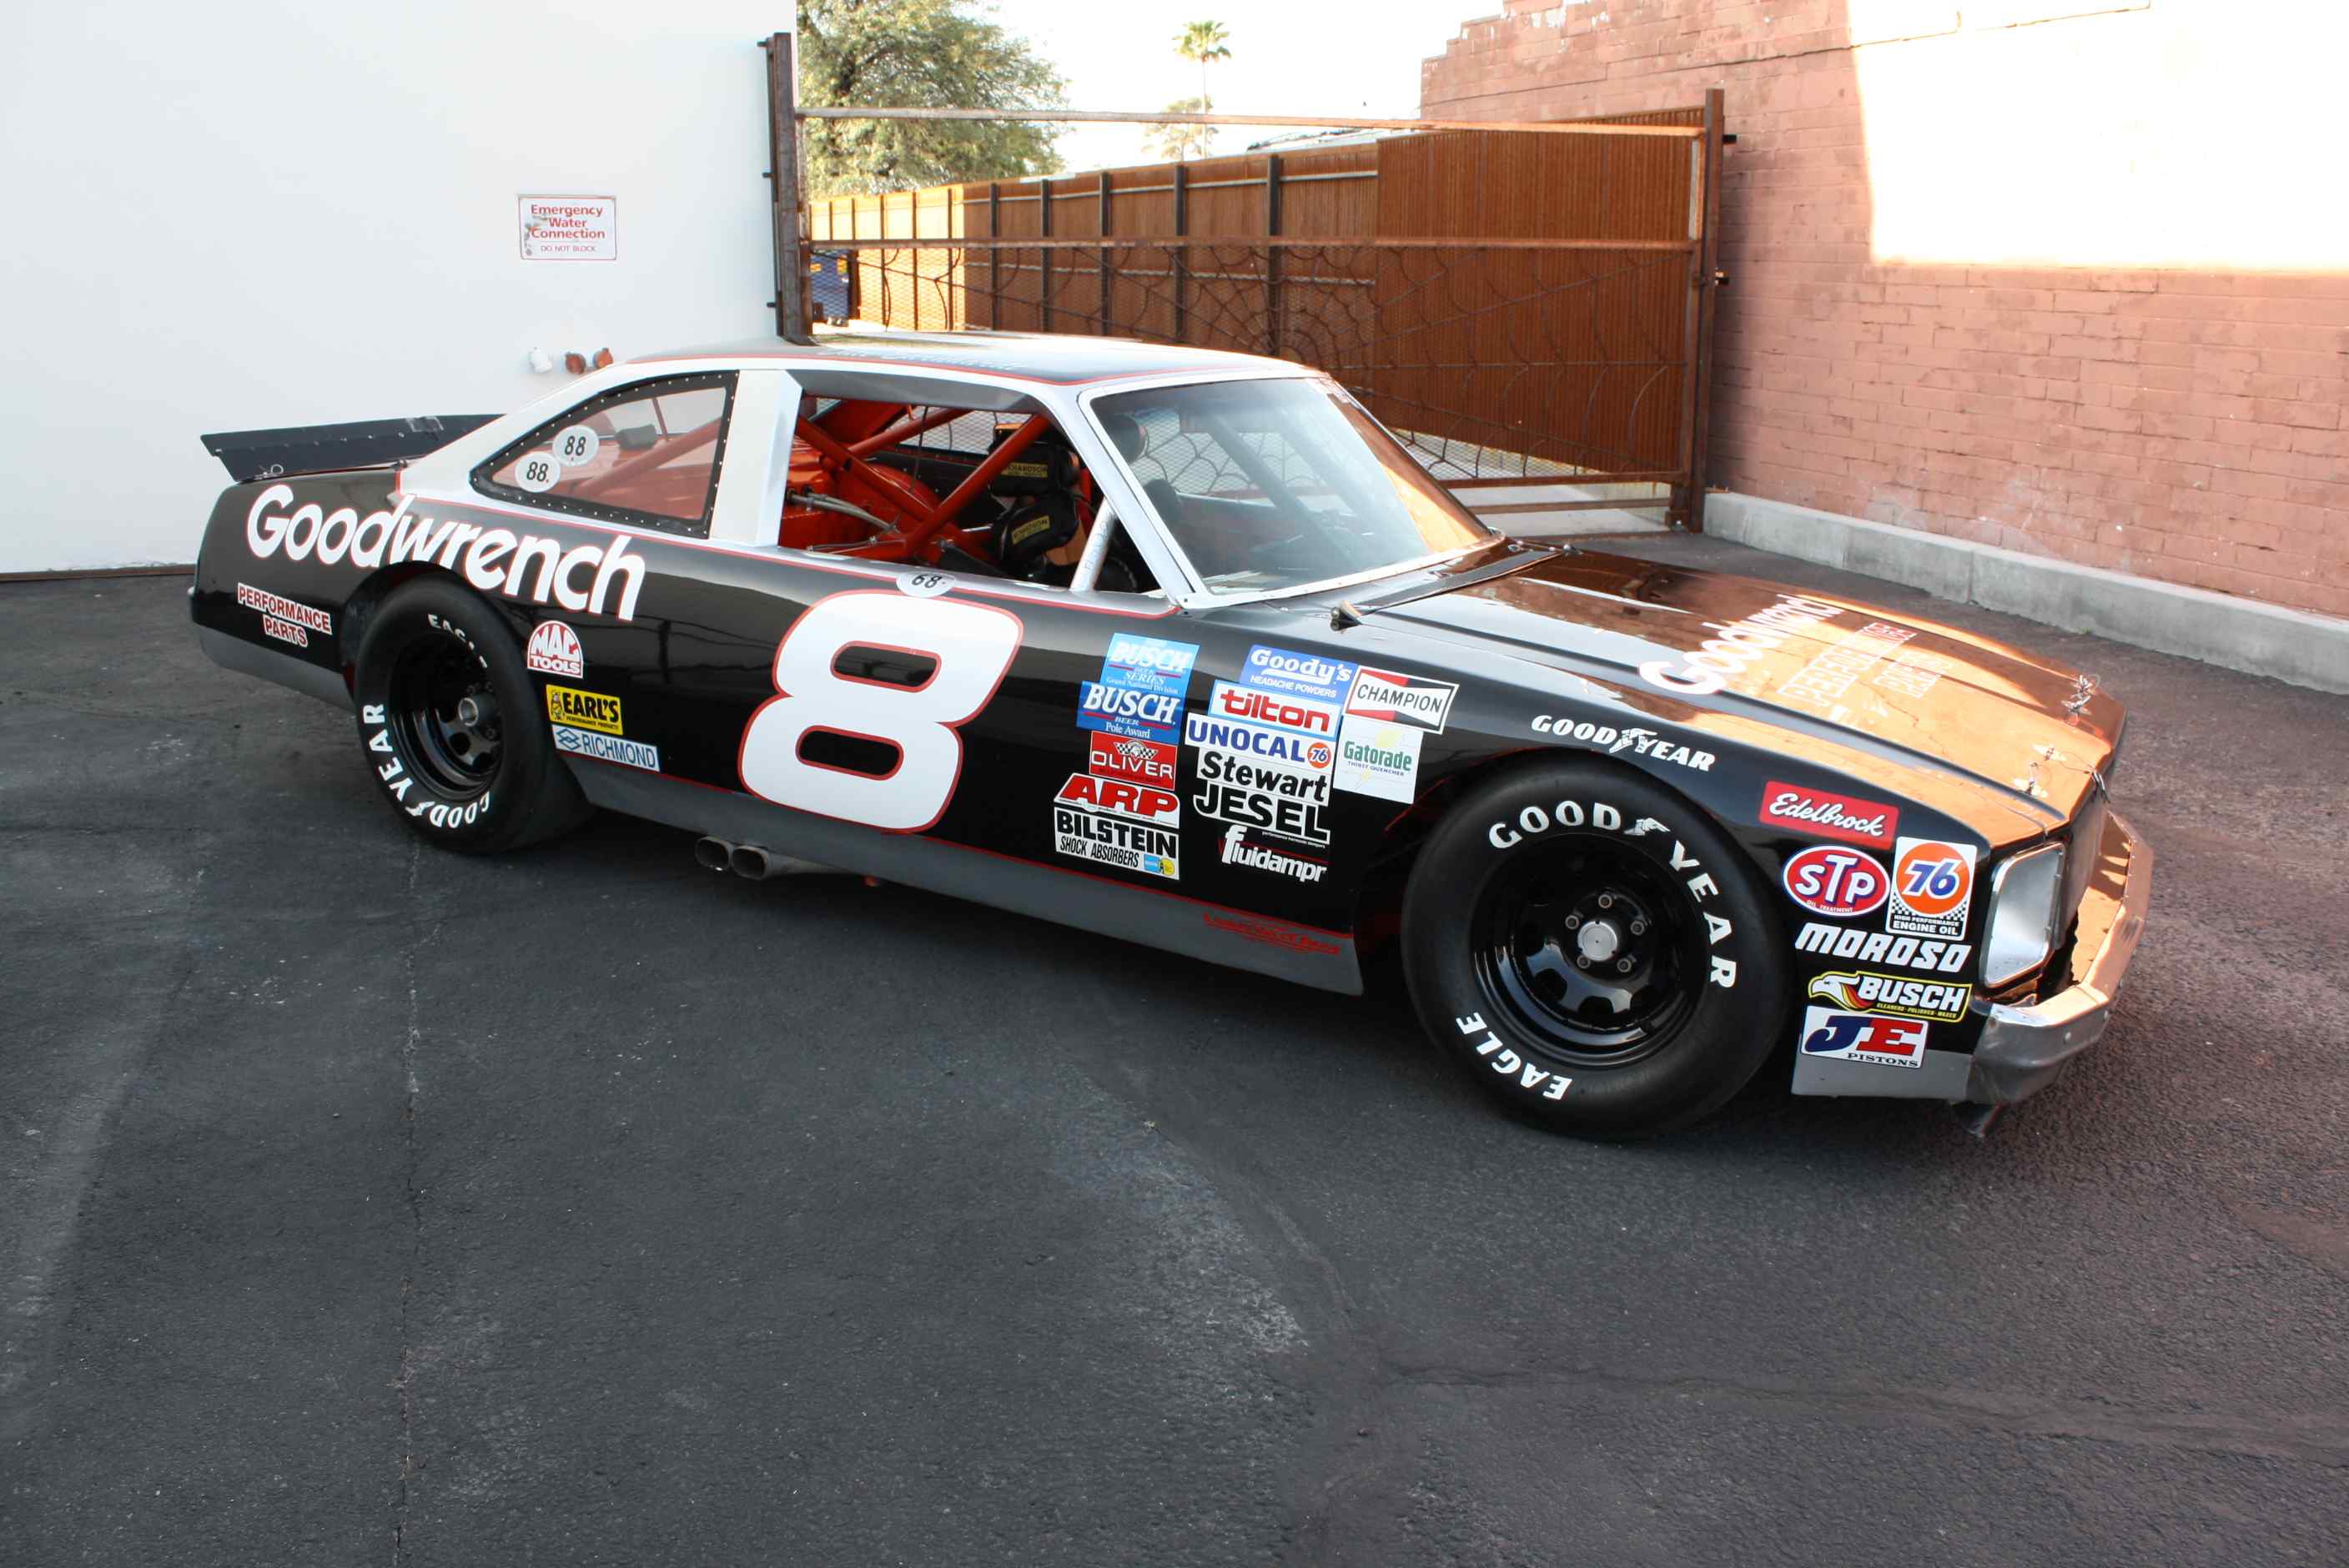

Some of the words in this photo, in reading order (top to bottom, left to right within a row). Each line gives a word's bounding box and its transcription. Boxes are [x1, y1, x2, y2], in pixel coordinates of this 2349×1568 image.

[531, 204, 603, 217] Emergency
[548, 218, 587, 228] Water
[531, 229, 606, 239] Connection
[565, 435, 586, 456] 88
[248, 485, 646, 621] Goodwrench
[911, 573, 943, 589] 68
[239, 585, 331, 633] PERFORMANCE
[264, 616, 308, 646] PARTS
[531, 625, 580, 661] MAC
[532, 656, 581, 674] TOOLS
[1109, 641, 1194, 673] BUSCH
[1250, 648, 1352, 686] Goody's
[1124, 671, 1166, 684] SERIES
[1250, 675, 1294, 691] HEADACHE
[1295, 683, 1337, 697] POWDERS
[562, 691, 619, 723] EARL'S
[737, 589, 1024, 834] 8
[1084, 684, 1181, 724] BUSCH
[1220, 689, 1330, 732] tilton
[1356, 683, 1444, 714] CHAMPION
[1105, 721, 1123, 734] Pole
[1125, 725, 1150, 739] Award
[1114, 716, 1139, 726] BEER
[582, 735, 656, 768] RICHMOND
[1189, 719, 1305, 763] UNOCAL
[1308, 748, 1330, 763] 76
[1343, 740, 1413, 772] Gatorade
[1091, 751, 1174, 780] OLIVER
[1200, 751, 1329, 803] Stewart
[1347, 761, 1369, 770] THIRST
[1370, 765, 1406, 776] QUENCHER
[1059, 776, 1179, 817] ARP
[1195, 783, 1330, 845] JESEL
[1768, 792, 1885, 837] Edelbrock
[1057, 809, 1177, 859] BILSTEIN
[1060, 835, 1088, 857] SHOCK
[1090, 842, 1140, 868] ABSORBERS
[1221, 824, 1329, 883] fluidampr
[1794, 854, 1876, 905] STP
[1902, 857, 1962, 900] 76
[1807, 899, 1817, 907] OIL
[1819, 904, 1854, 913] TREATMENT
[1912, 916, 1960, 927] PERFORMANCE
[1892, 920, 1936, 933] ENGINE
[1939, 926, 1959, 935] OIL
[1795, 922, 1972, 972] MOROSO
[1858, 976, 1966, 1012] BUSCH
[1804, 1015, 1924, 1057] JE
[1455, 1012, 1572, 1101] EAGLE
[1847, 1053, 1919, 1068] PISTONS
